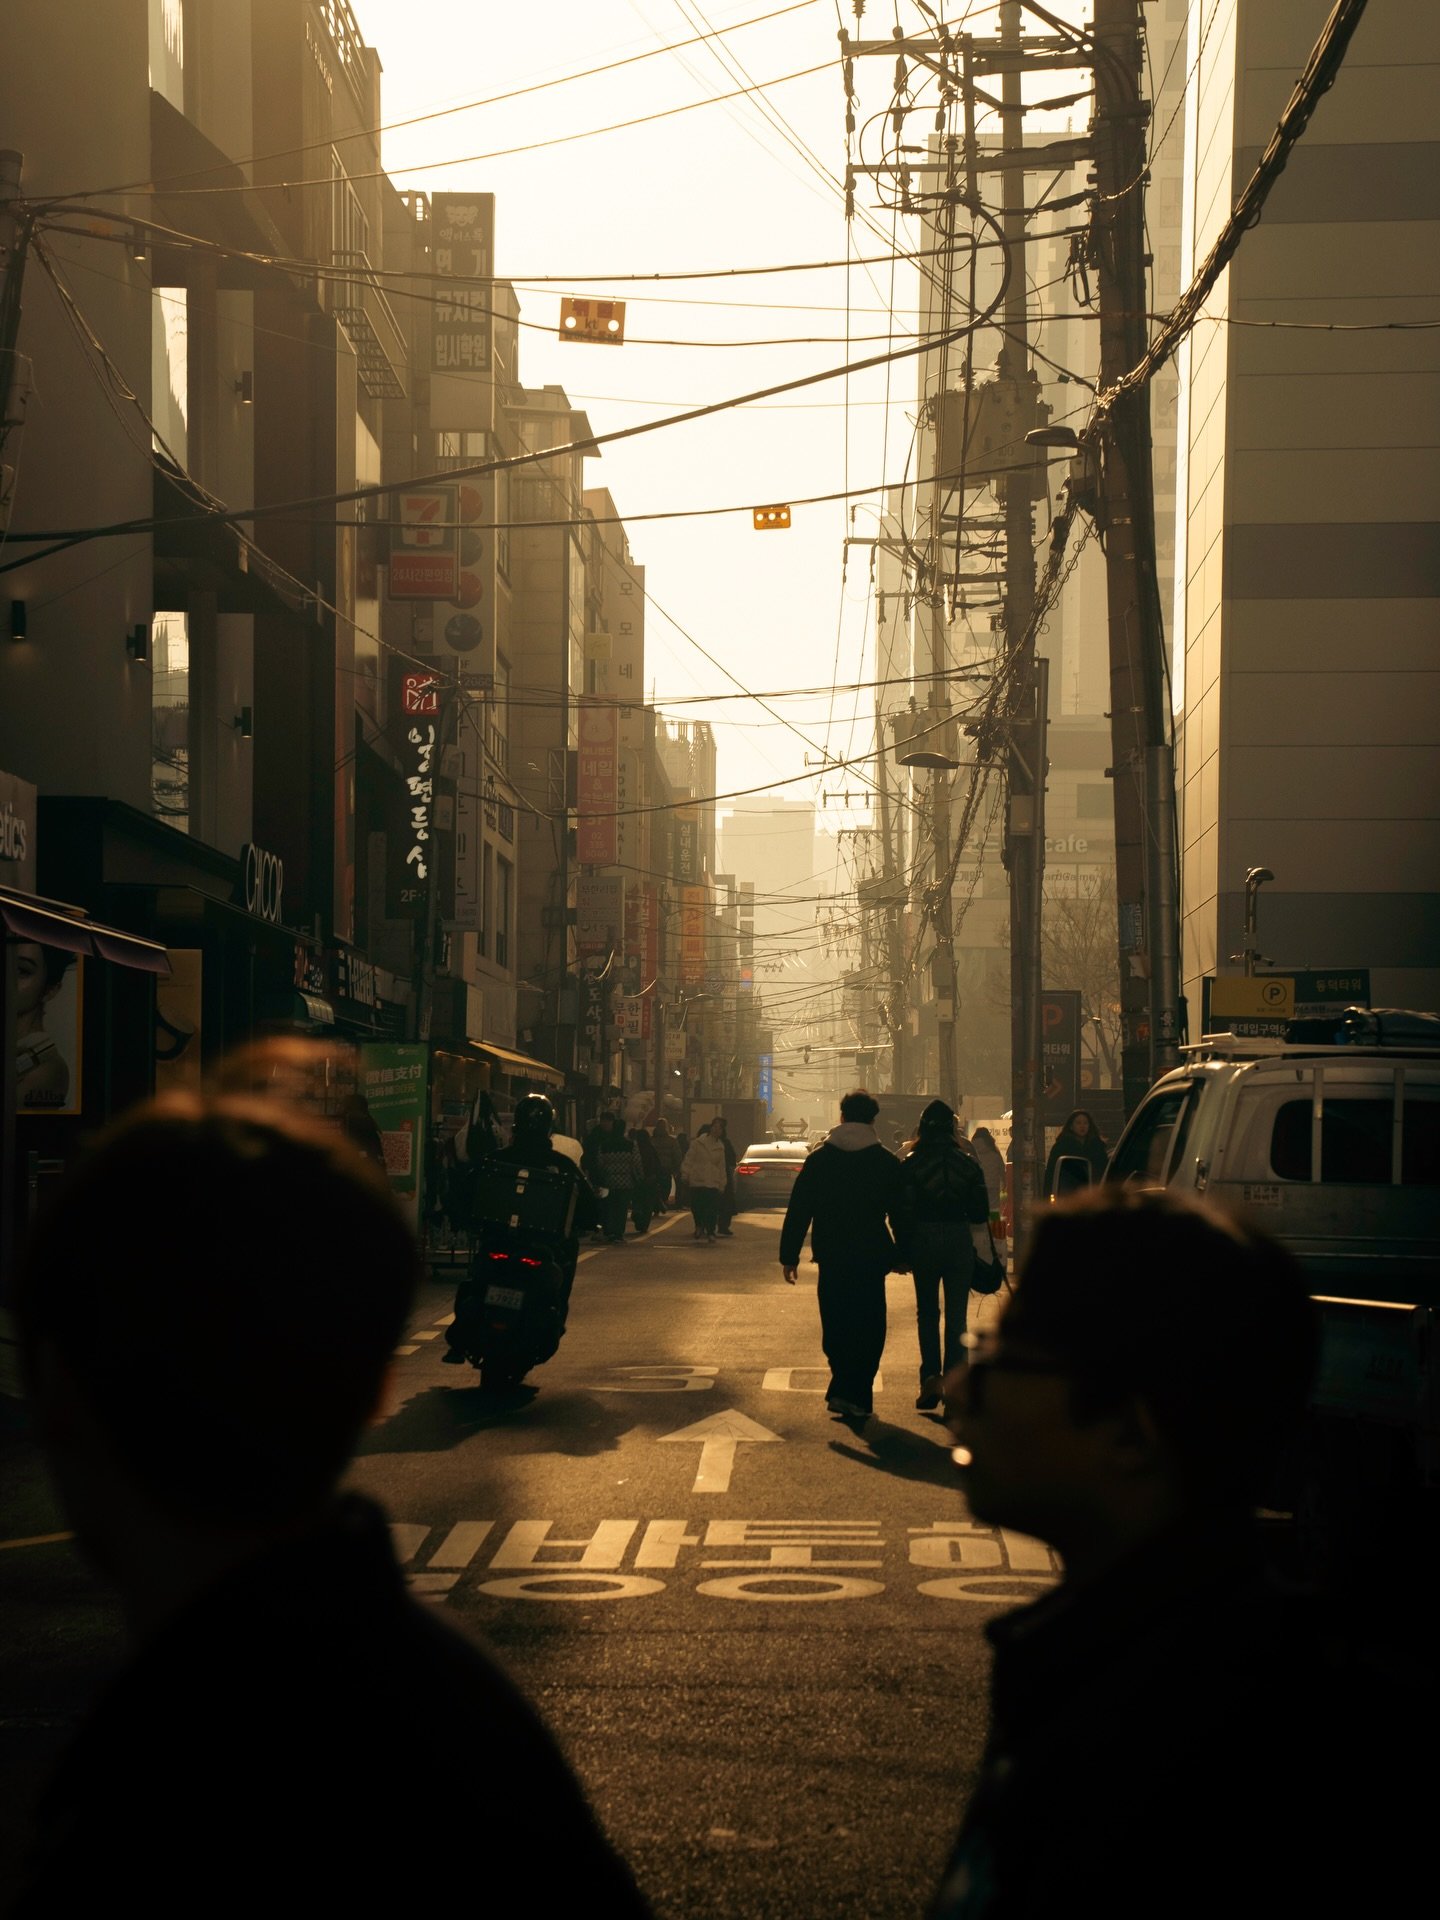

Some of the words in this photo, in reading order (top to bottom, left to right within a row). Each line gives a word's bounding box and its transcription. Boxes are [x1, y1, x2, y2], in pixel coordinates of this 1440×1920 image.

[435, 290, 486, 322] 뮤지컬
[435, 333, 486, 367] 입시학원
[392, 567, 453, 584] 24시간편의점
[582, 759, 613, 777] 네일
[246, 842, 284, 925] CHICOR
[1315, 977, 1361, 993] 동덕타워
[366, 1063, 422, 1085] 微信支付
